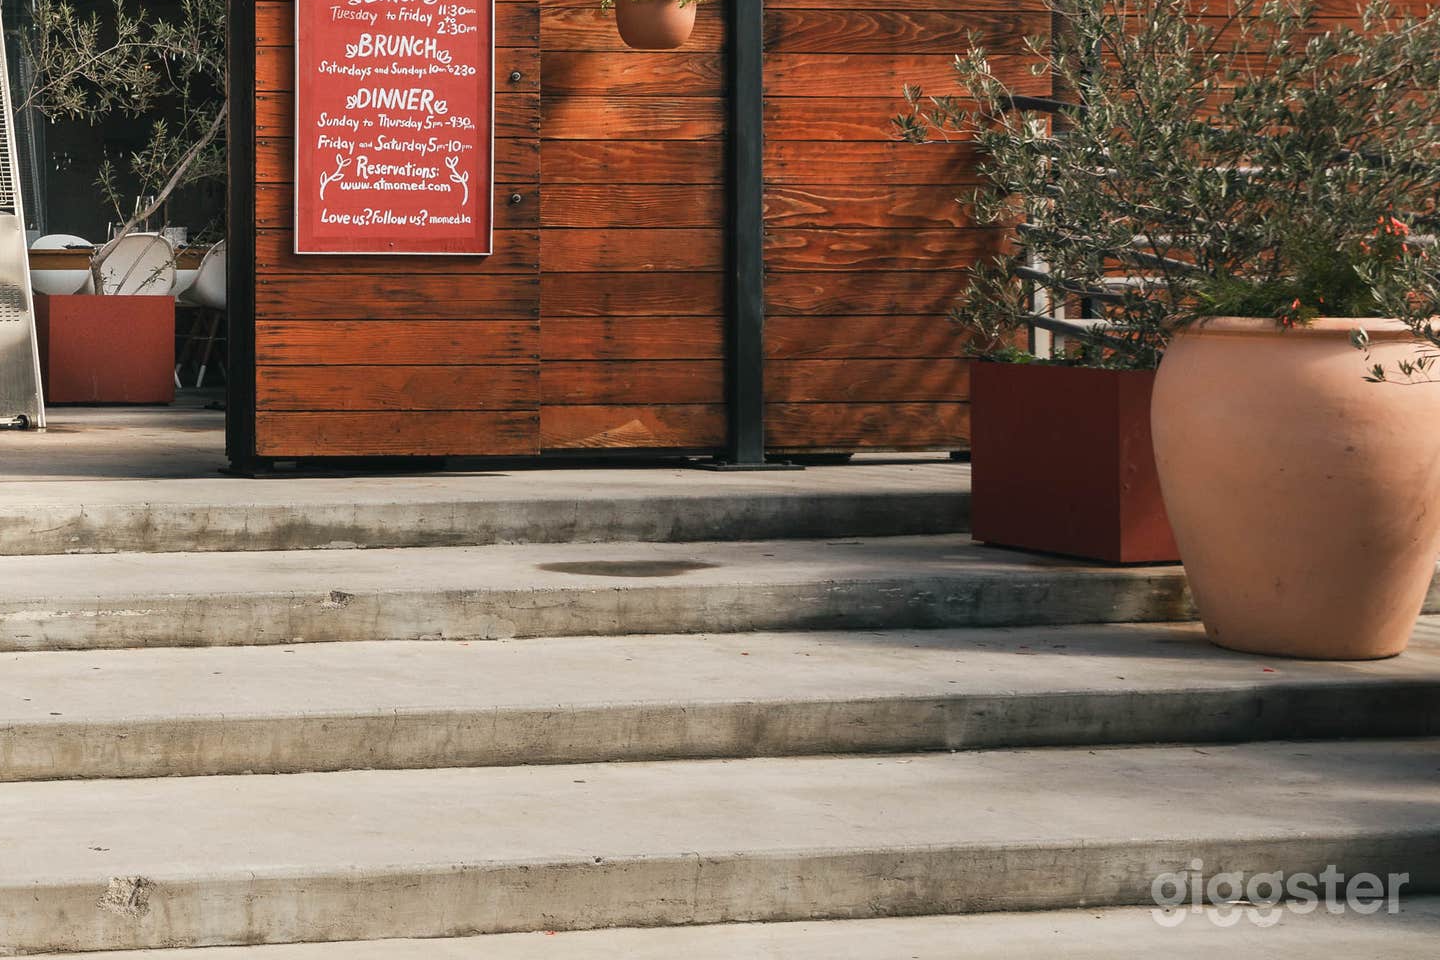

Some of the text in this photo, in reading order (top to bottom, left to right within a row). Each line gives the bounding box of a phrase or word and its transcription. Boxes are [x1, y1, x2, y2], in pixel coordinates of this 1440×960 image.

[330, 6, 378, 26] Tuesday
[386, 12, 396, 21] to
[398, 7, 433, 27] Friday
[359, 33, 437, 59] BRUNCH
[318, 61, 371, 80] Saturdays
[374, 65, 389, 75] and
[391, 62, 427, 79] Sundays
[357, 87, 434, 115] DINNER
[317, 113, 359, 132] Sunday
[363, 119, 373, 127] to
[378, 114, 422, 131] Thursday
[317, 135, 354, 154] Friday
[374, 135, 427, 156] Saturday
[356, 155, 439, 178] Reservations:
[340, 178, 451, 192] www.atmomed.com
[321, 208, 471, 226] Love us? Follow us? momed.la
